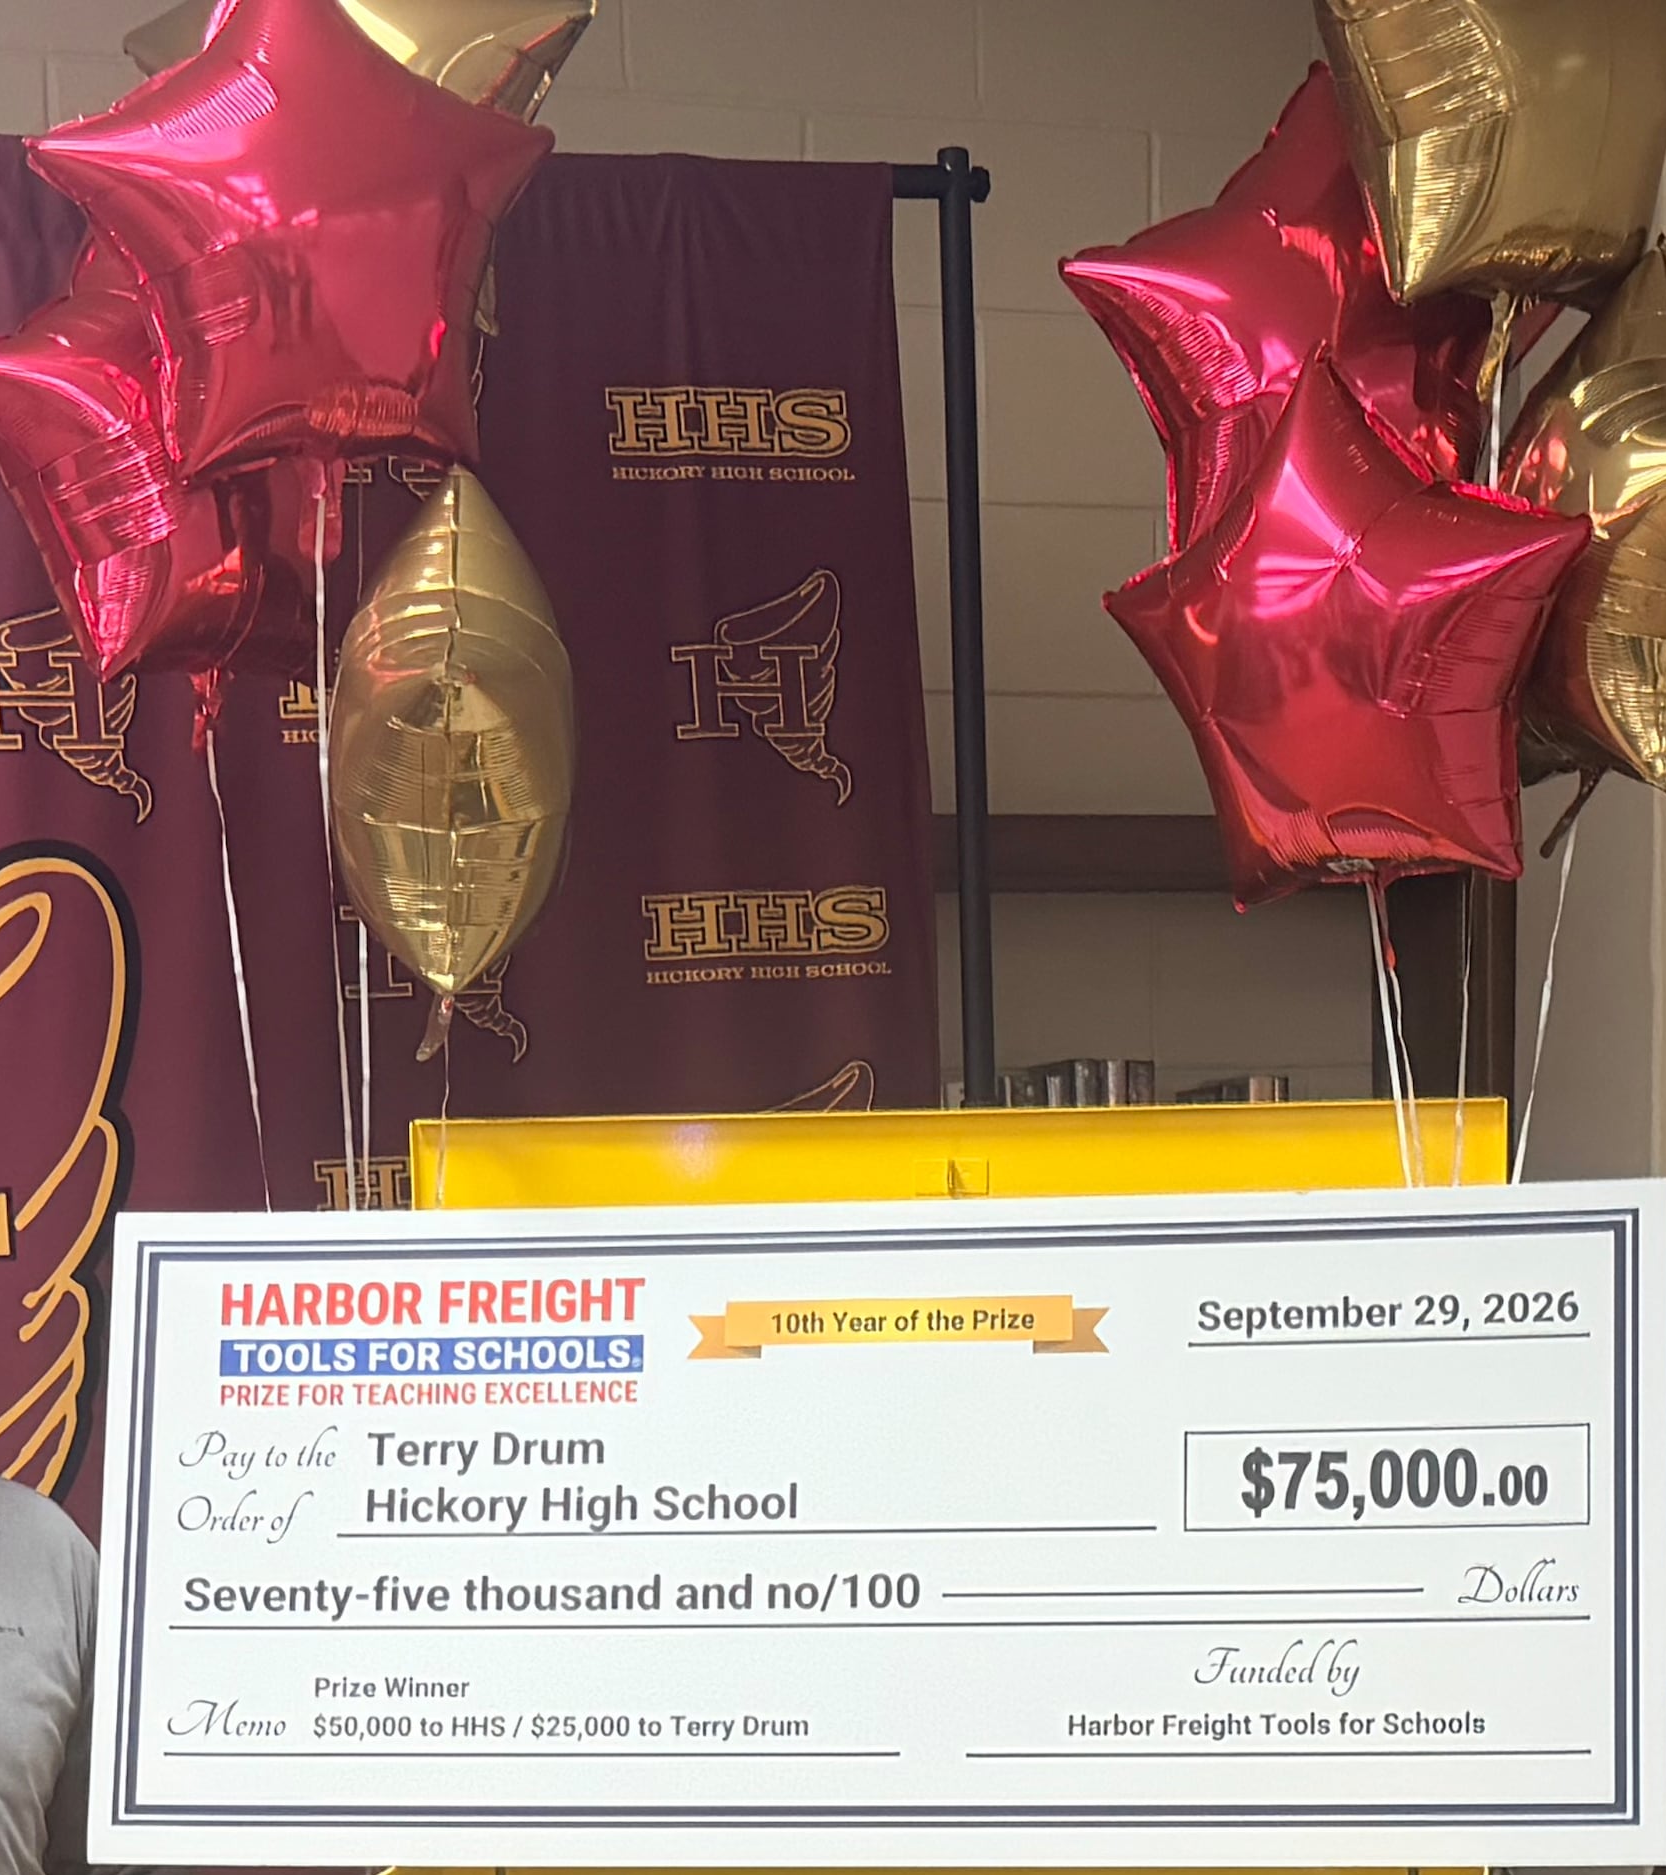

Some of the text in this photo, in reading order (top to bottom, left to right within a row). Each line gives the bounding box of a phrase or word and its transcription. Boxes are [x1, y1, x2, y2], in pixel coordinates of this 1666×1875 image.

[605, 387, 852, 456] HHS
[613, 464, 856, 482] HICKORY HIGH SCHOOL
[643, 886, 889, 960] HHS
[646, 961, 893, 985] HICKORY HIGH SCHOOL
[221, 1278, 645, 1326] HARBOR FREIGHT
[772, 1308, 1034, 1334] 10th Year of the Prize
[1198, 1291, 1578, 1338] September 29, 2026
[234, 1338, 631, 1373] TOOLS FOR SCHOOLS
[221, 1380, 638, 1406] PRIZE FOR TEACHING EXCELLENCE
[179, 1425, 338, 1480] Pay to the
[368, 1432, 604, 1476] Terry Drum
[1242, 1447, 1548, 1520] $75,000.00
[178, 1489, 314, 1544] Order of
[366, 1482, 797, 1532] Hickory High School
[185, 1558, 1579, 1621] Seventy-five thousand and no/100 Dollars
[315, 1677, 469, 1698] Prize Winner
[1194, 1639, 1360, 1697] Funded by
[167, 1700, 286, 1736] Memo
[313, 1714, 411, 1741] $50,000
[420, 1718, 443, 1737] to
[452, 1716, 505, 1737] HHS
[531, 1713, 630, 1741] $25,000
[639, 1717, 662, 1736] to
[670, 1716, 735, 1741] Terry
[743, 1716, 808, 1736] Drum
[1069, 1711, 1485, 1741] Harbor Freight Tools for Schools
